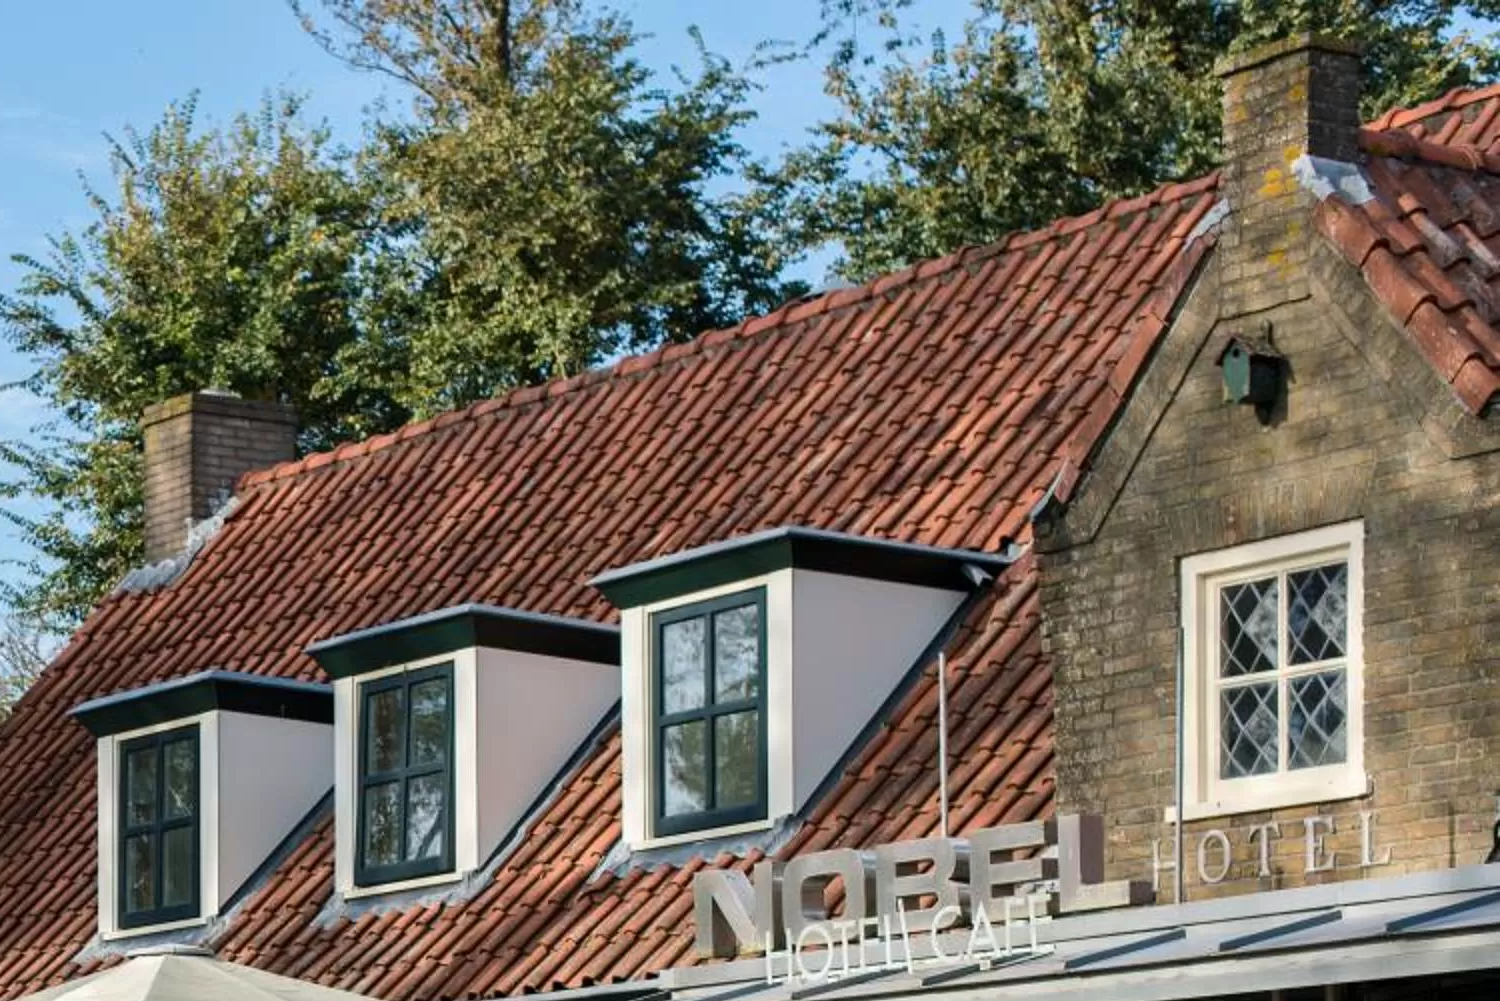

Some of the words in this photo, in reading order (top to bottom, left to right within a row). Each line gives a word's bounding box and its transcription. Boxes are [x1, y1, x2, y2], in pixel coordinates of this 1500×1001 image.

[693, 813, 1154, 959] NOBEL
[1152, 810, 1393, 892] HOTEL
[765, 914, 900, 986] HOTEL
